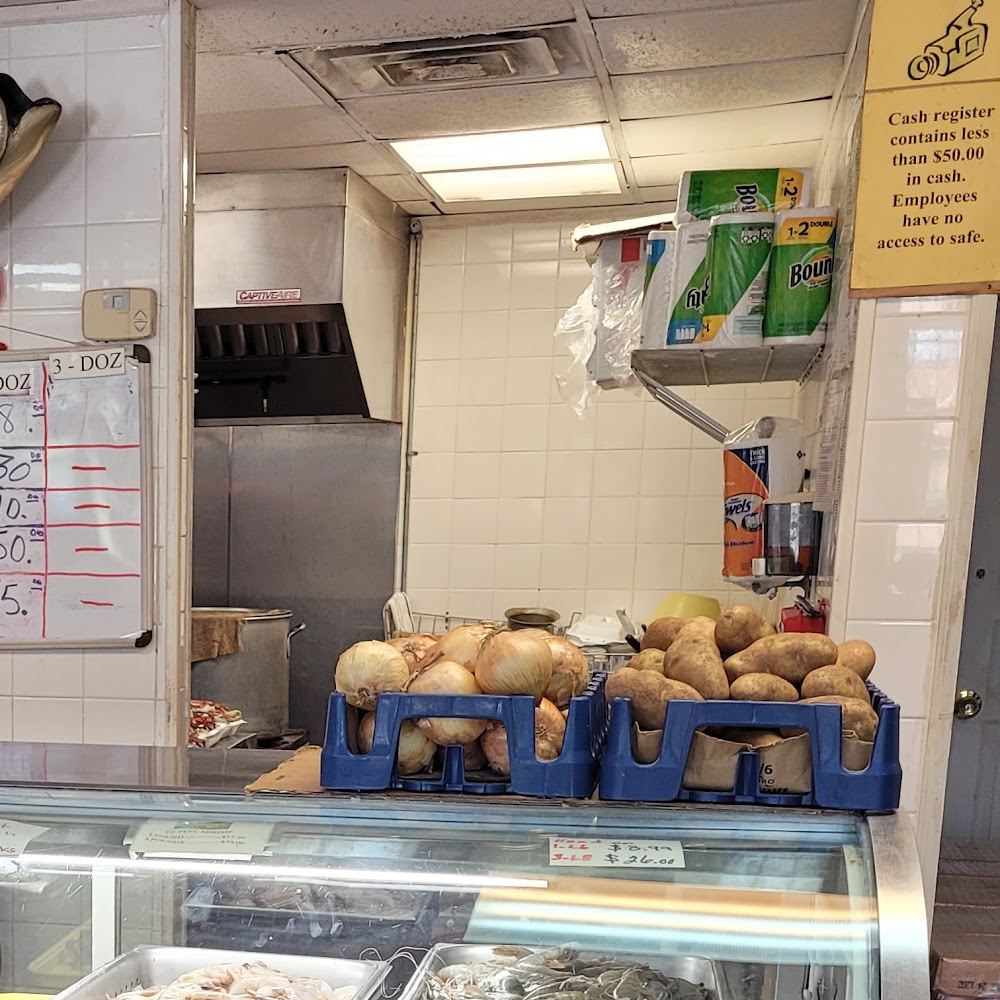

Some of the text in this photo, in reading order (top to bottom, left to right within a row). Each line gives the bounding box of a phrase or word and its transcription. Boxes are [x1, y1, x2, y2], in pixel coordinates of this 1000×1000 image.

[888, 106, 995, 126] Cash register
[890, 126, 990, 146] contains less
[892, 147, 984, 167] than $50.00
[906, 170, 967, 186] in cash.
[892, 190, 978, 209] Employees
[902, 212, 963, 227] have no
[877, 229, 985, 250] access to safe.
[790, 257, 832, 288] Boun
[79, 352, 122, 373] DOZ
